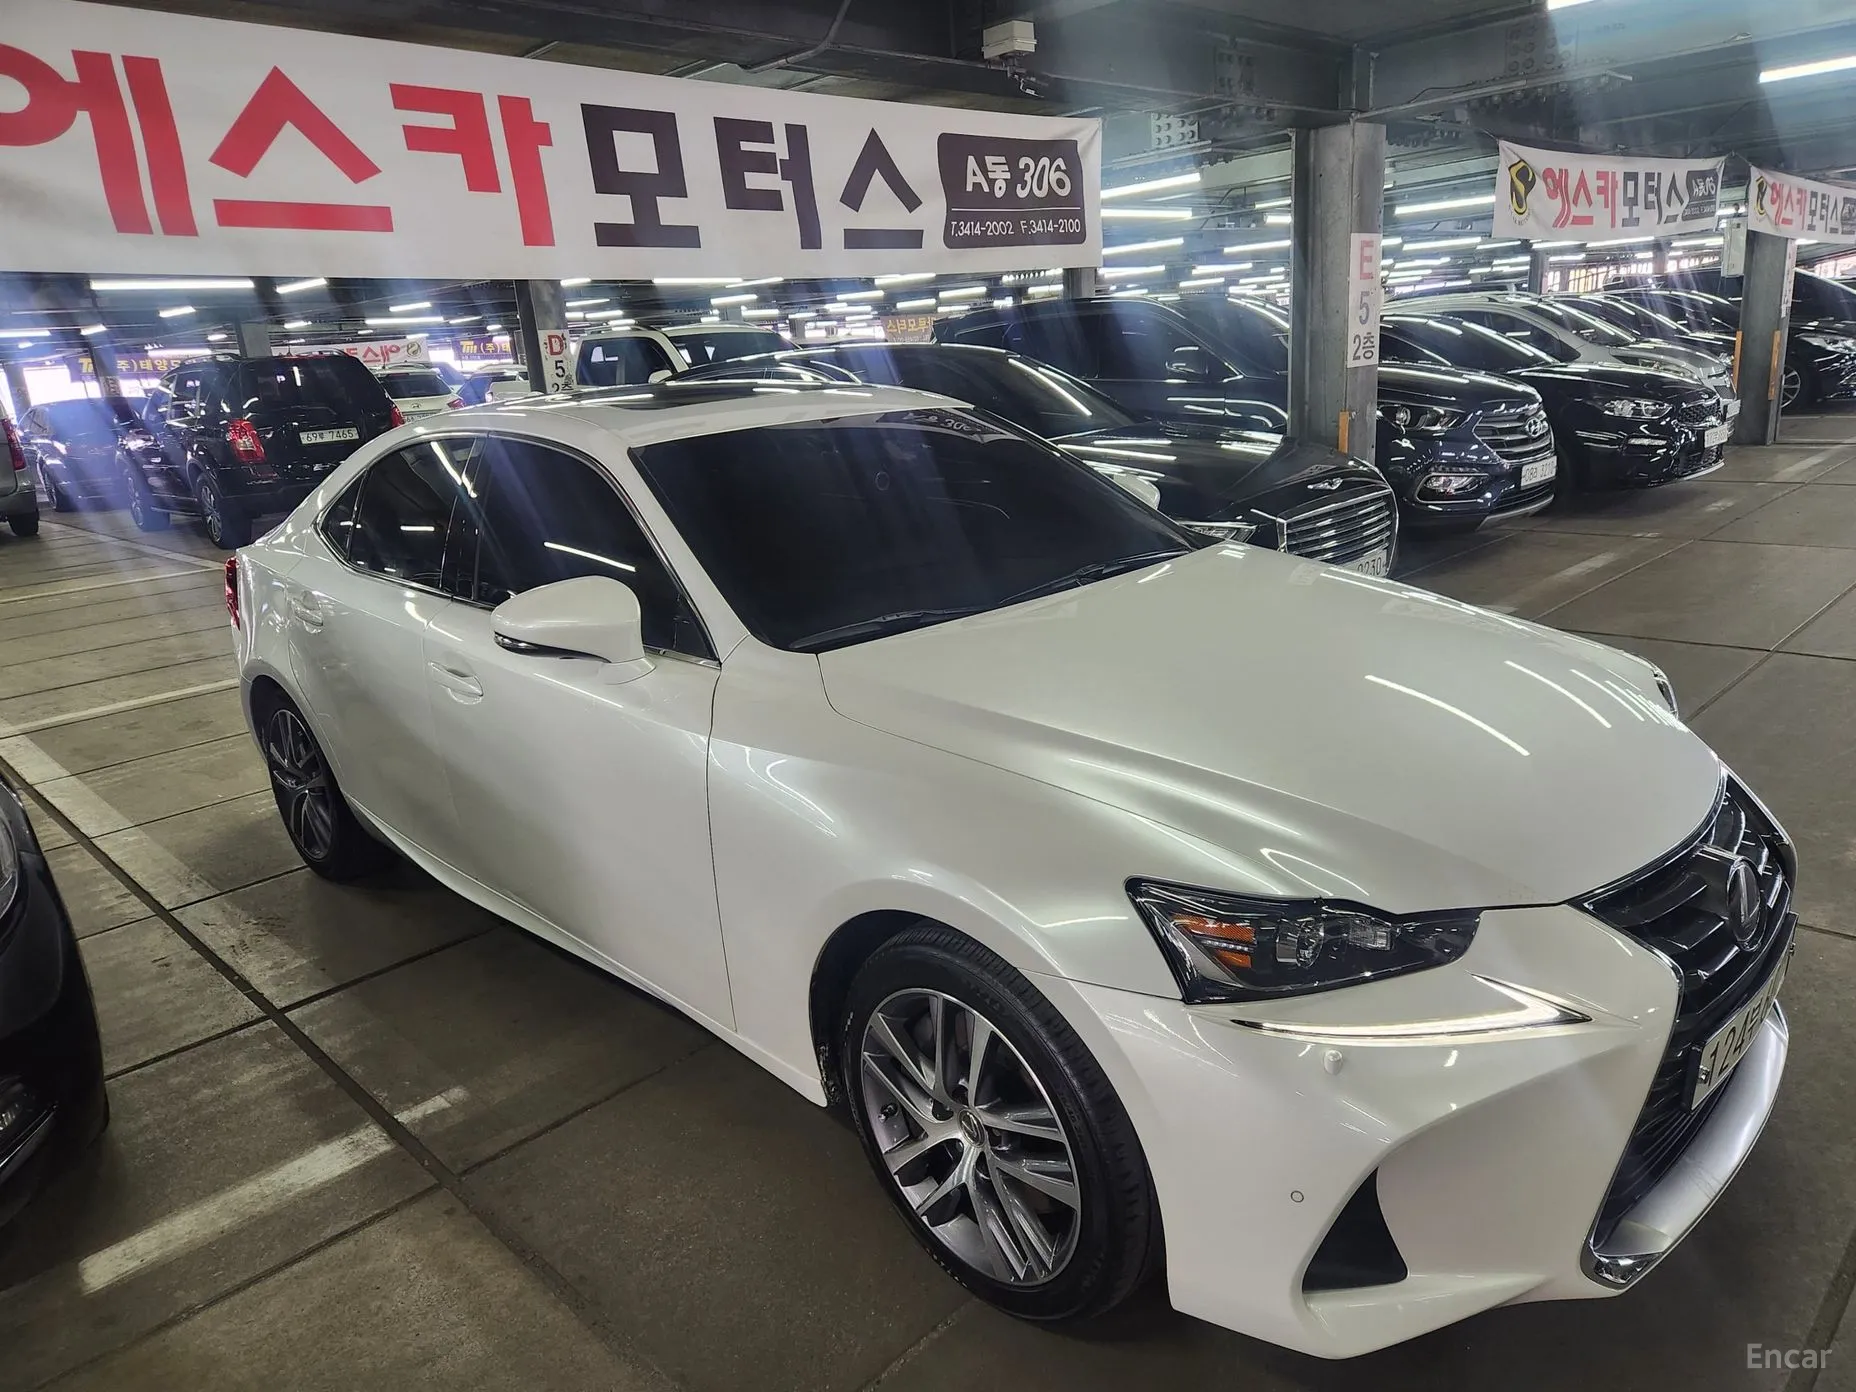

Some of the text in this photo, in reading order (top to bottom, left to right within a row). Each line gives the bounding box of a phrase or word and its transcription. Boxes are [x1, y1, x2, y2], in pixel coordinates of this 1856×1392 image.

[966, 155, 1071, 198] A동 306
[951, 218, 1081, 237] T.3414-2002 F.3414-2100
[1360, 240, 1374, 280] E
[1359, 291, 1370, 325] 5
[547, 335, 564, 355] D
[1352, 332, 1375, 361] 2층
[554, 360, 566, 378] 5
[328, 430, 354, 439] 7465
